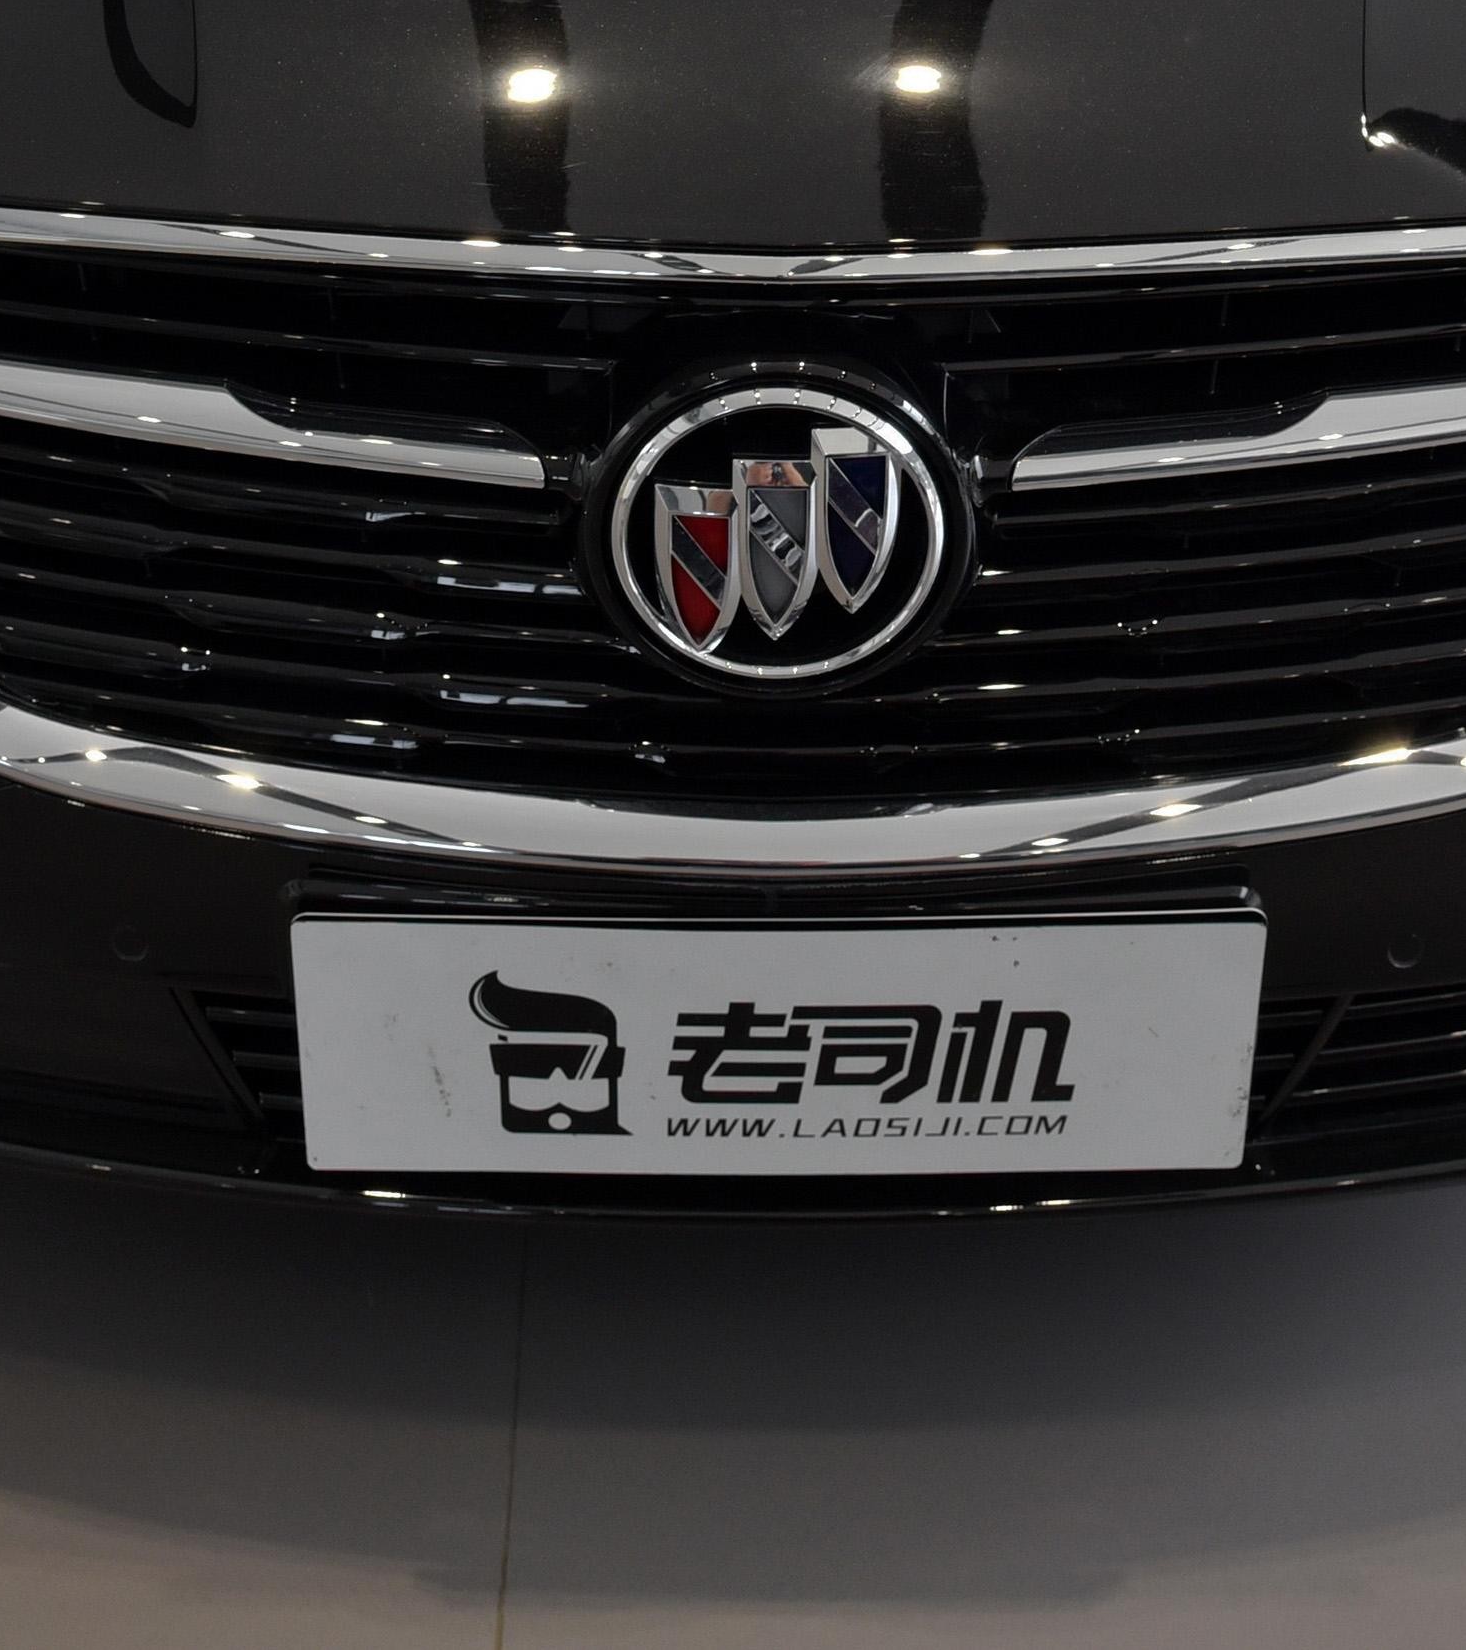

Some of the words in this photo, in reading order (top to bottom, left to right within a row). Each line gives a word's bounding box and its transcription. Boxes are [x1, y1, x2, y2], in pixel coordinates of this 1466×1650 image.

[667, 1000, 1076, 1104] 老司机
[666, 1114, 1068, 1139] WWW.LAOSIJI.COM
